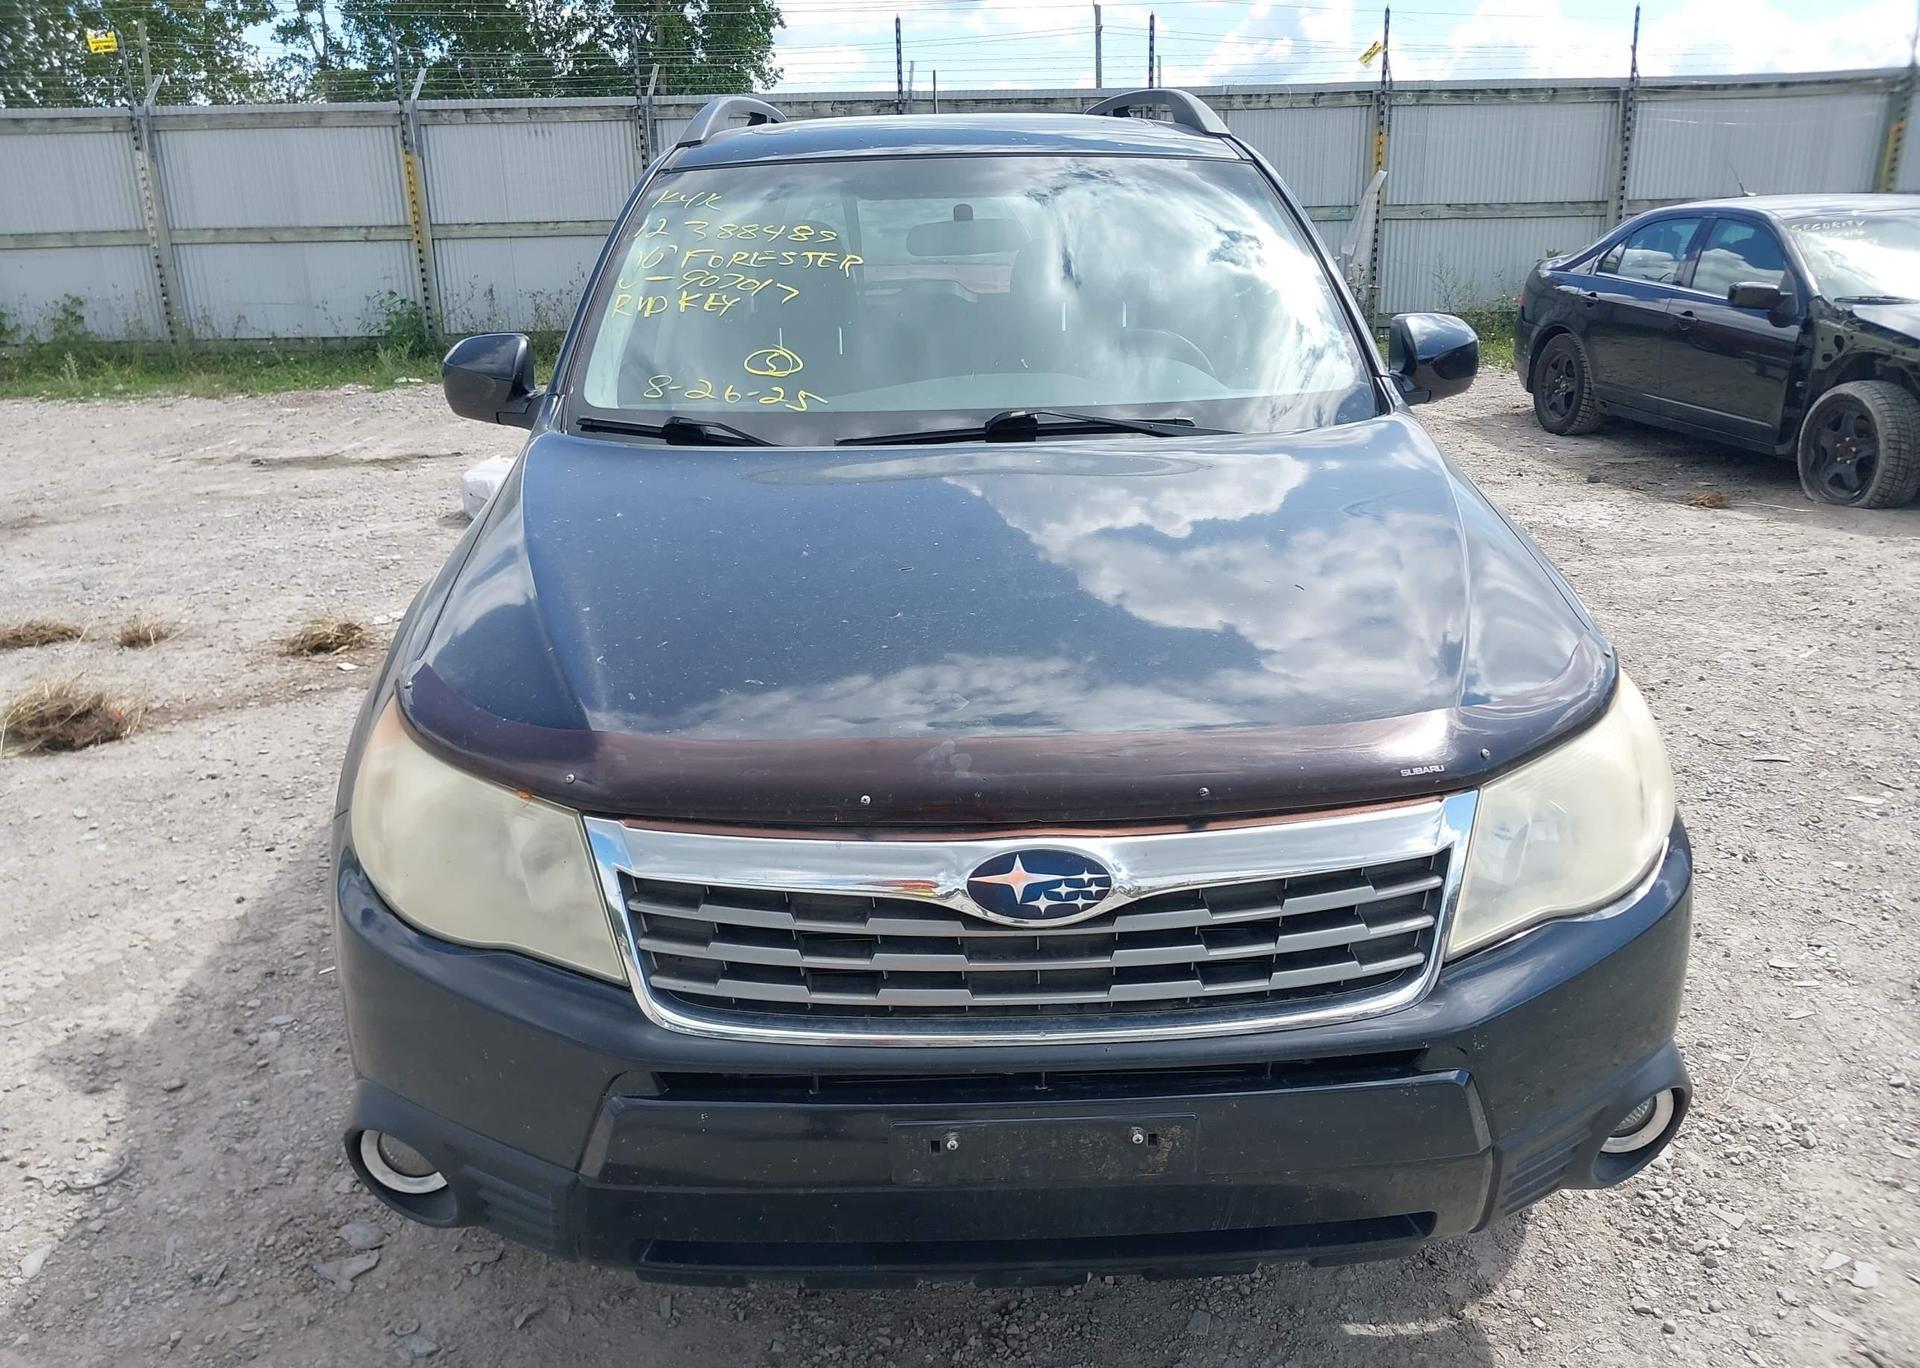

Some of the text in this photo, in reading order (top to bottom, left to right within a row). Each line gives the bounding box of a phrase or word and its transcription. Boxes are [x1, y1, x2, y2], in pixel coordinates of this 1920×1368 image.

[680, 249, 864, 278] FORESTER
[677, 289, 741, 317] KEY
[643, 374, 829, 412] 8-26-25
[1400, 764, 1446, 777] SUBARU
